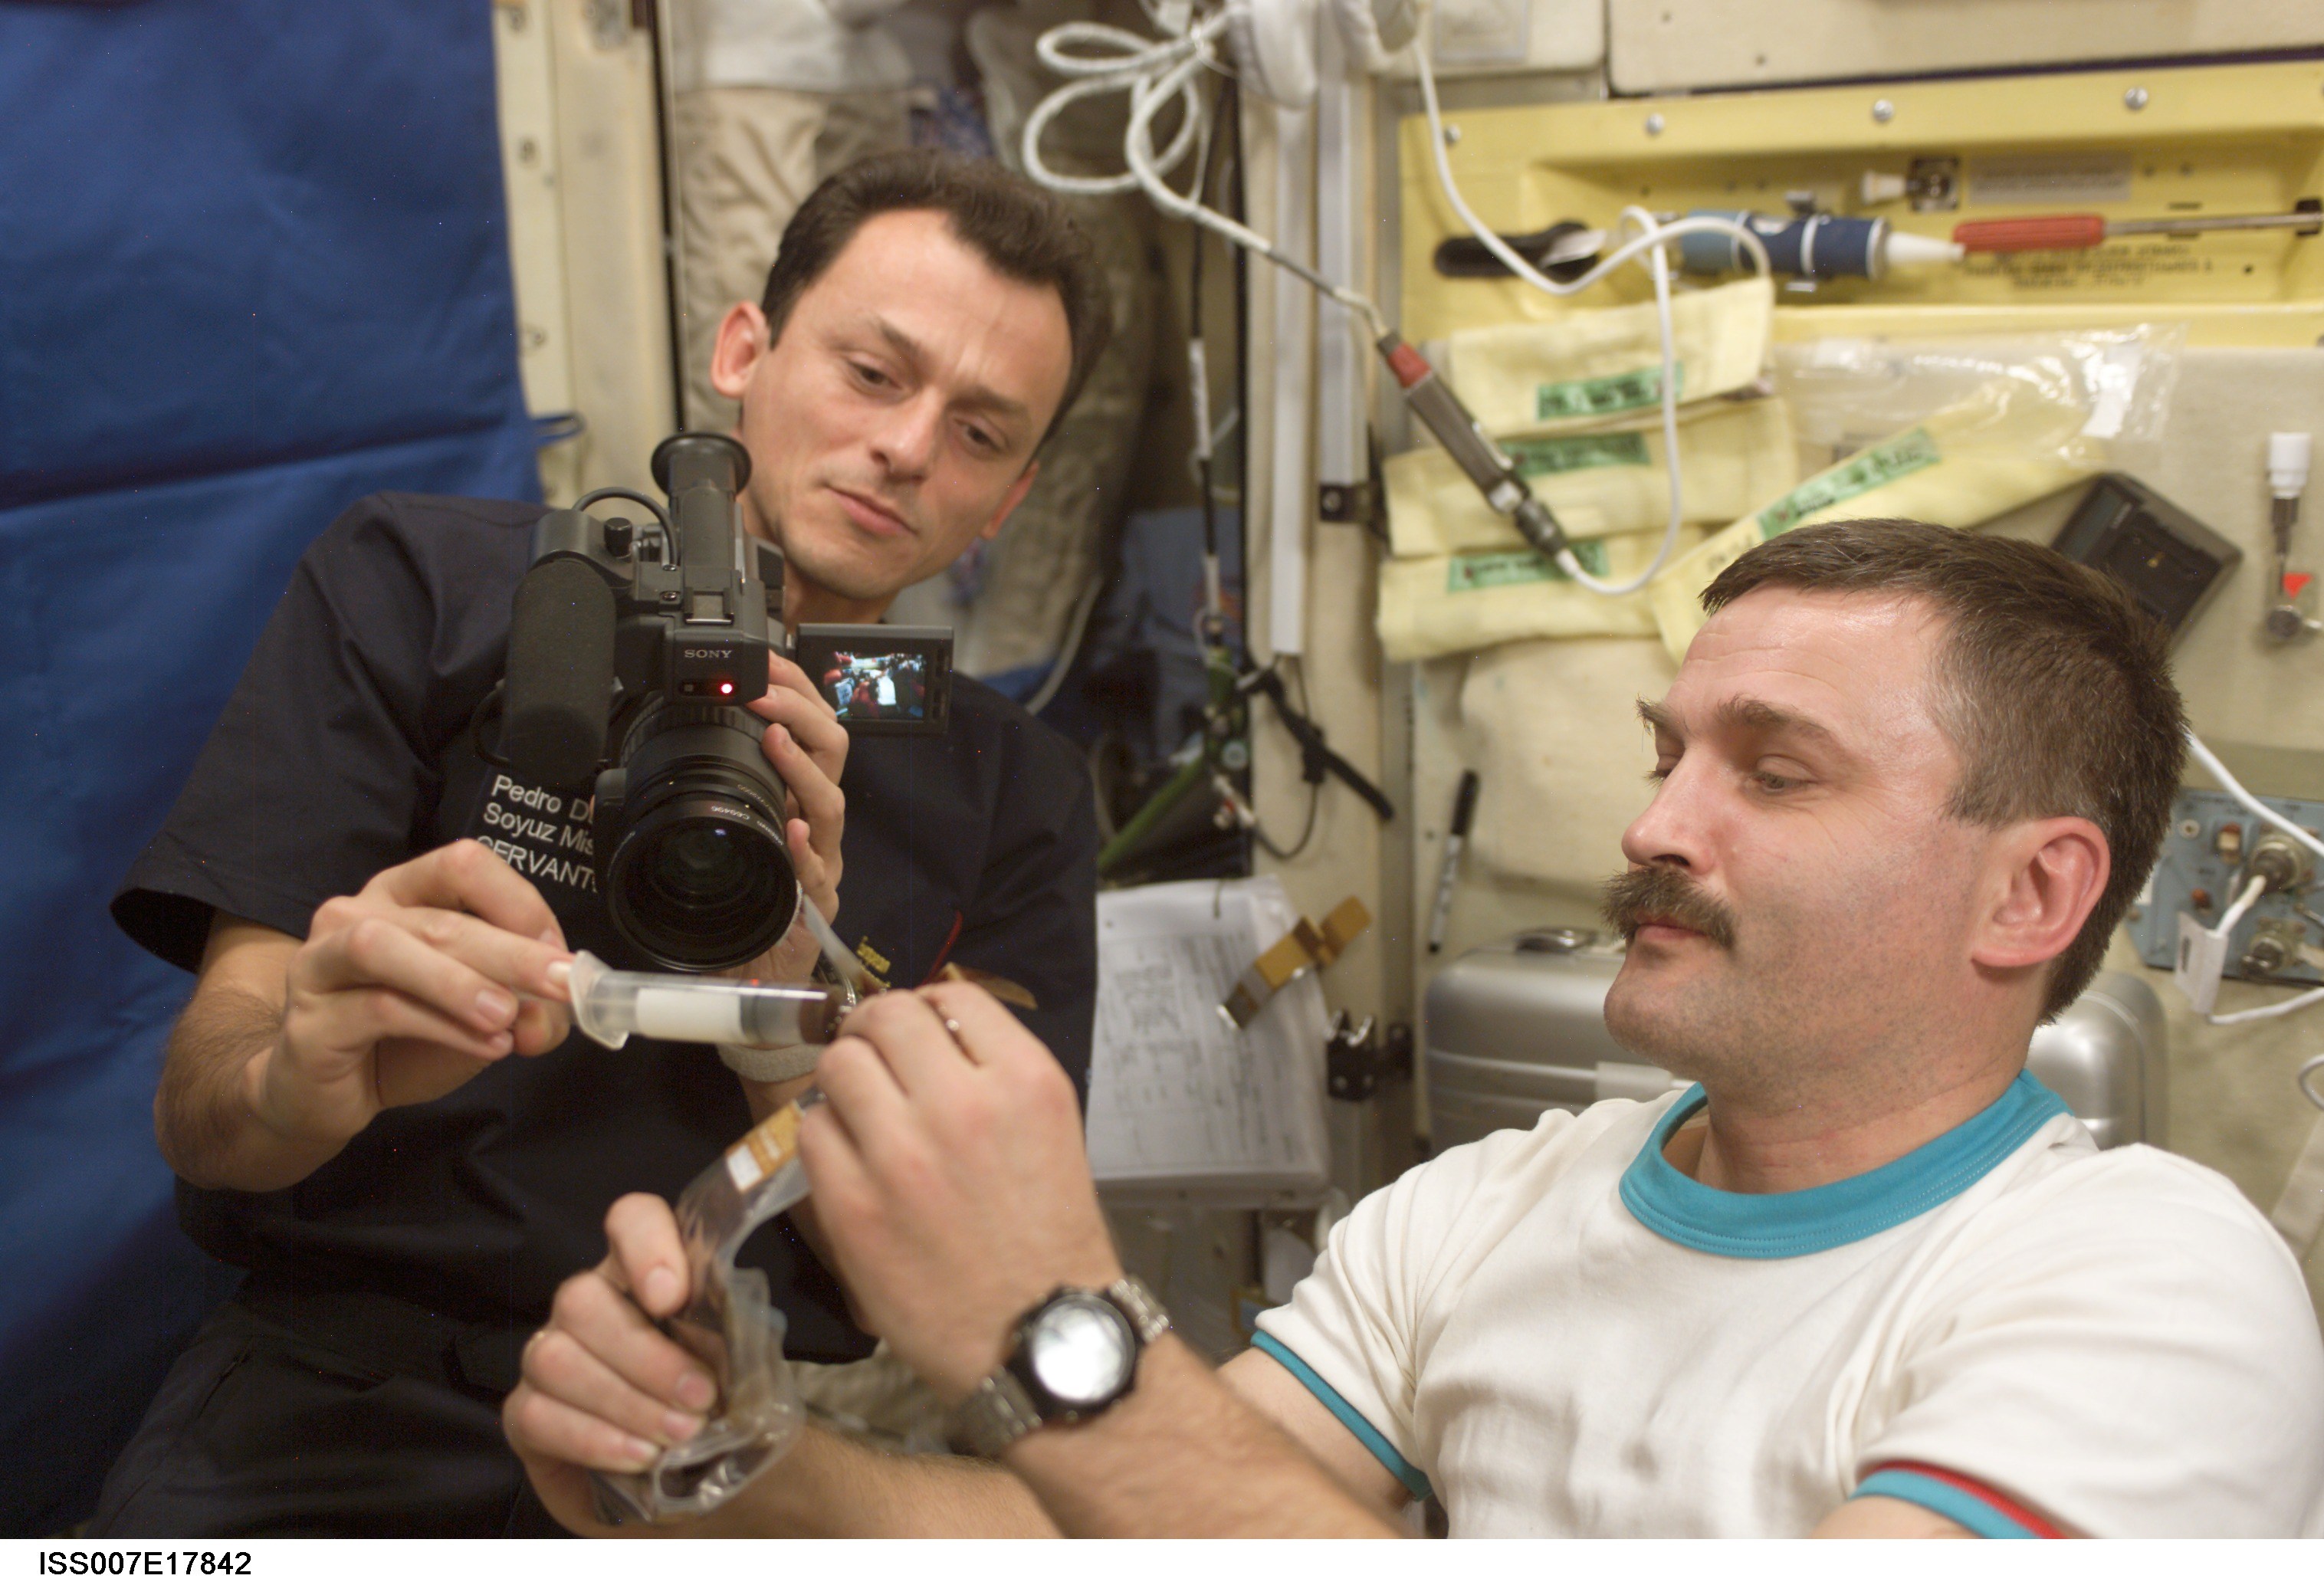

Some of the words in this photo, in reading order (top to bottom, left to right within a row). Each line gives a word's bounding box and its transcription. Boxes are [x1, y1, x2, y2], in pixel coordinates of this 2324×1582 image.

[684, 648, 732, 658] SONY
[491, 773, 562, 814] Pedro
[569, 797, 593, 825] D
[483, 802, 557, 843] Soyuz
